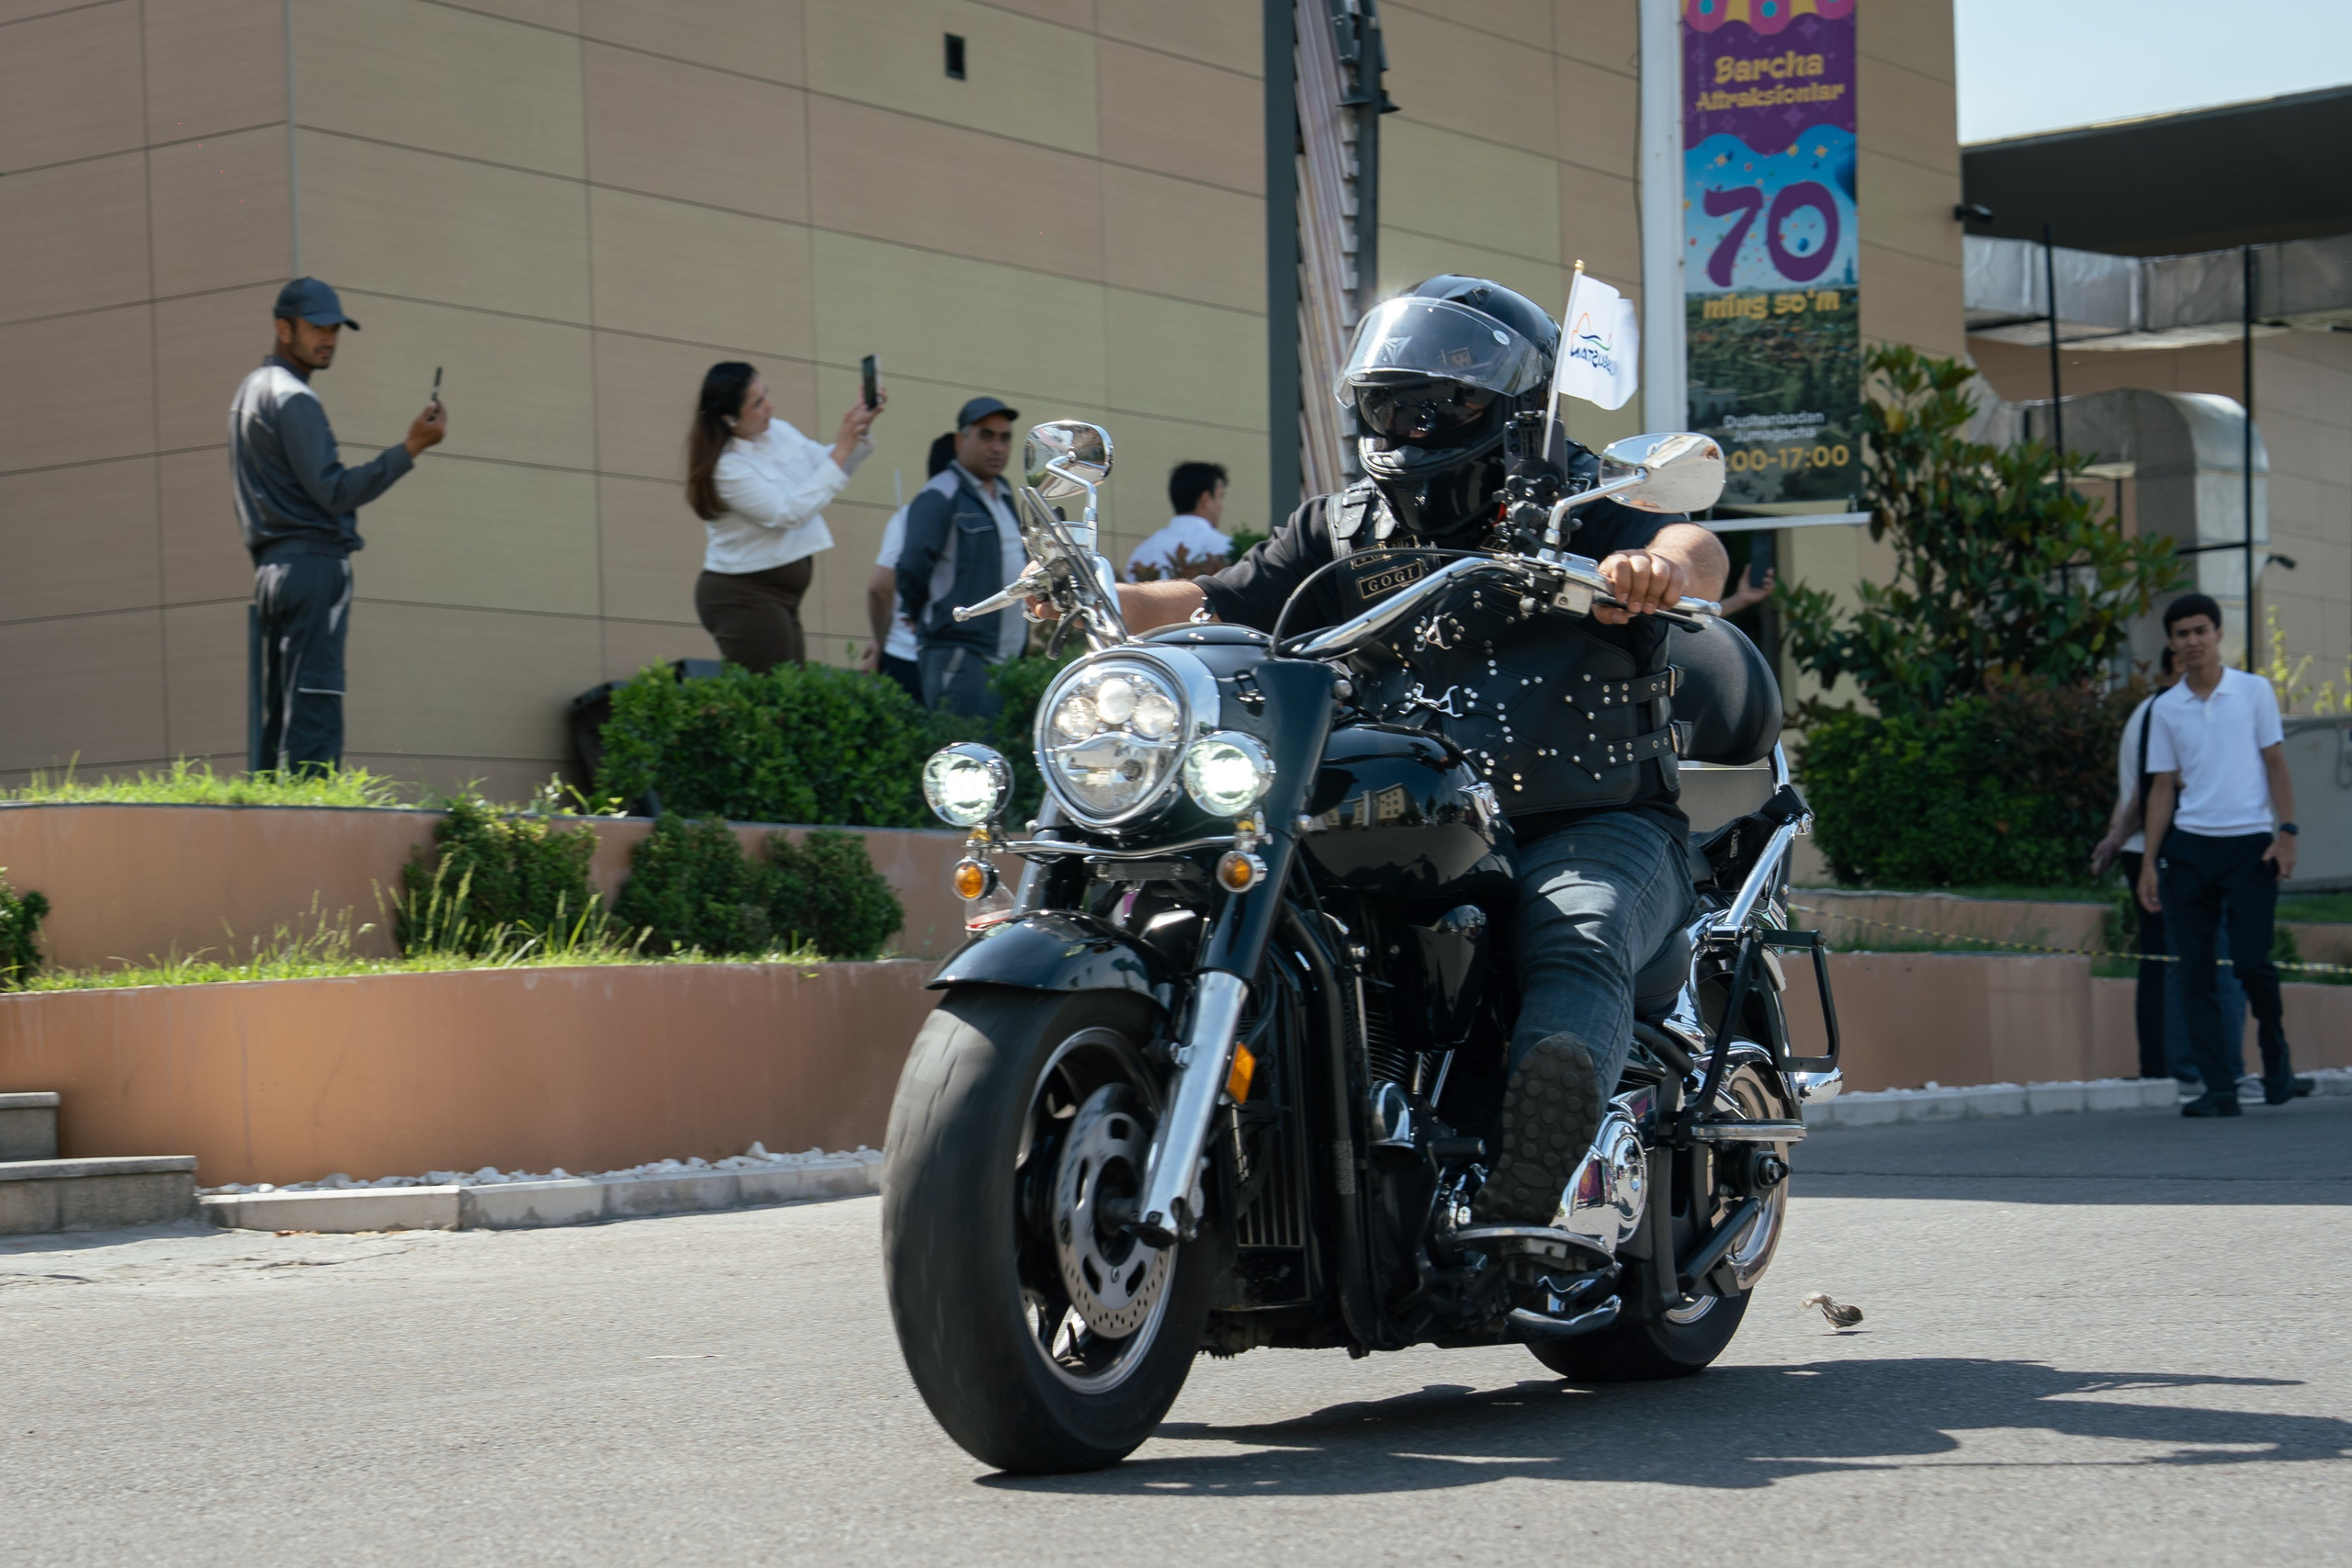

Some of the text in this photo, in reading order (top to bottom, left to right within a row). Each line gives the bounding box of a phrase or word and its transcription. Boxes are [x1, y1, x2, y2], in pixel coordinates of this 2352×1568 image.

[1713, 50, 1824, 85] Barcha
[1703, 180, 1840, 288] 70
[1702, 293, 1768, 320] ming
[1725, 445, 1849, 472] :00-17:00
[1367, 568, 1414, 592] GOGI
